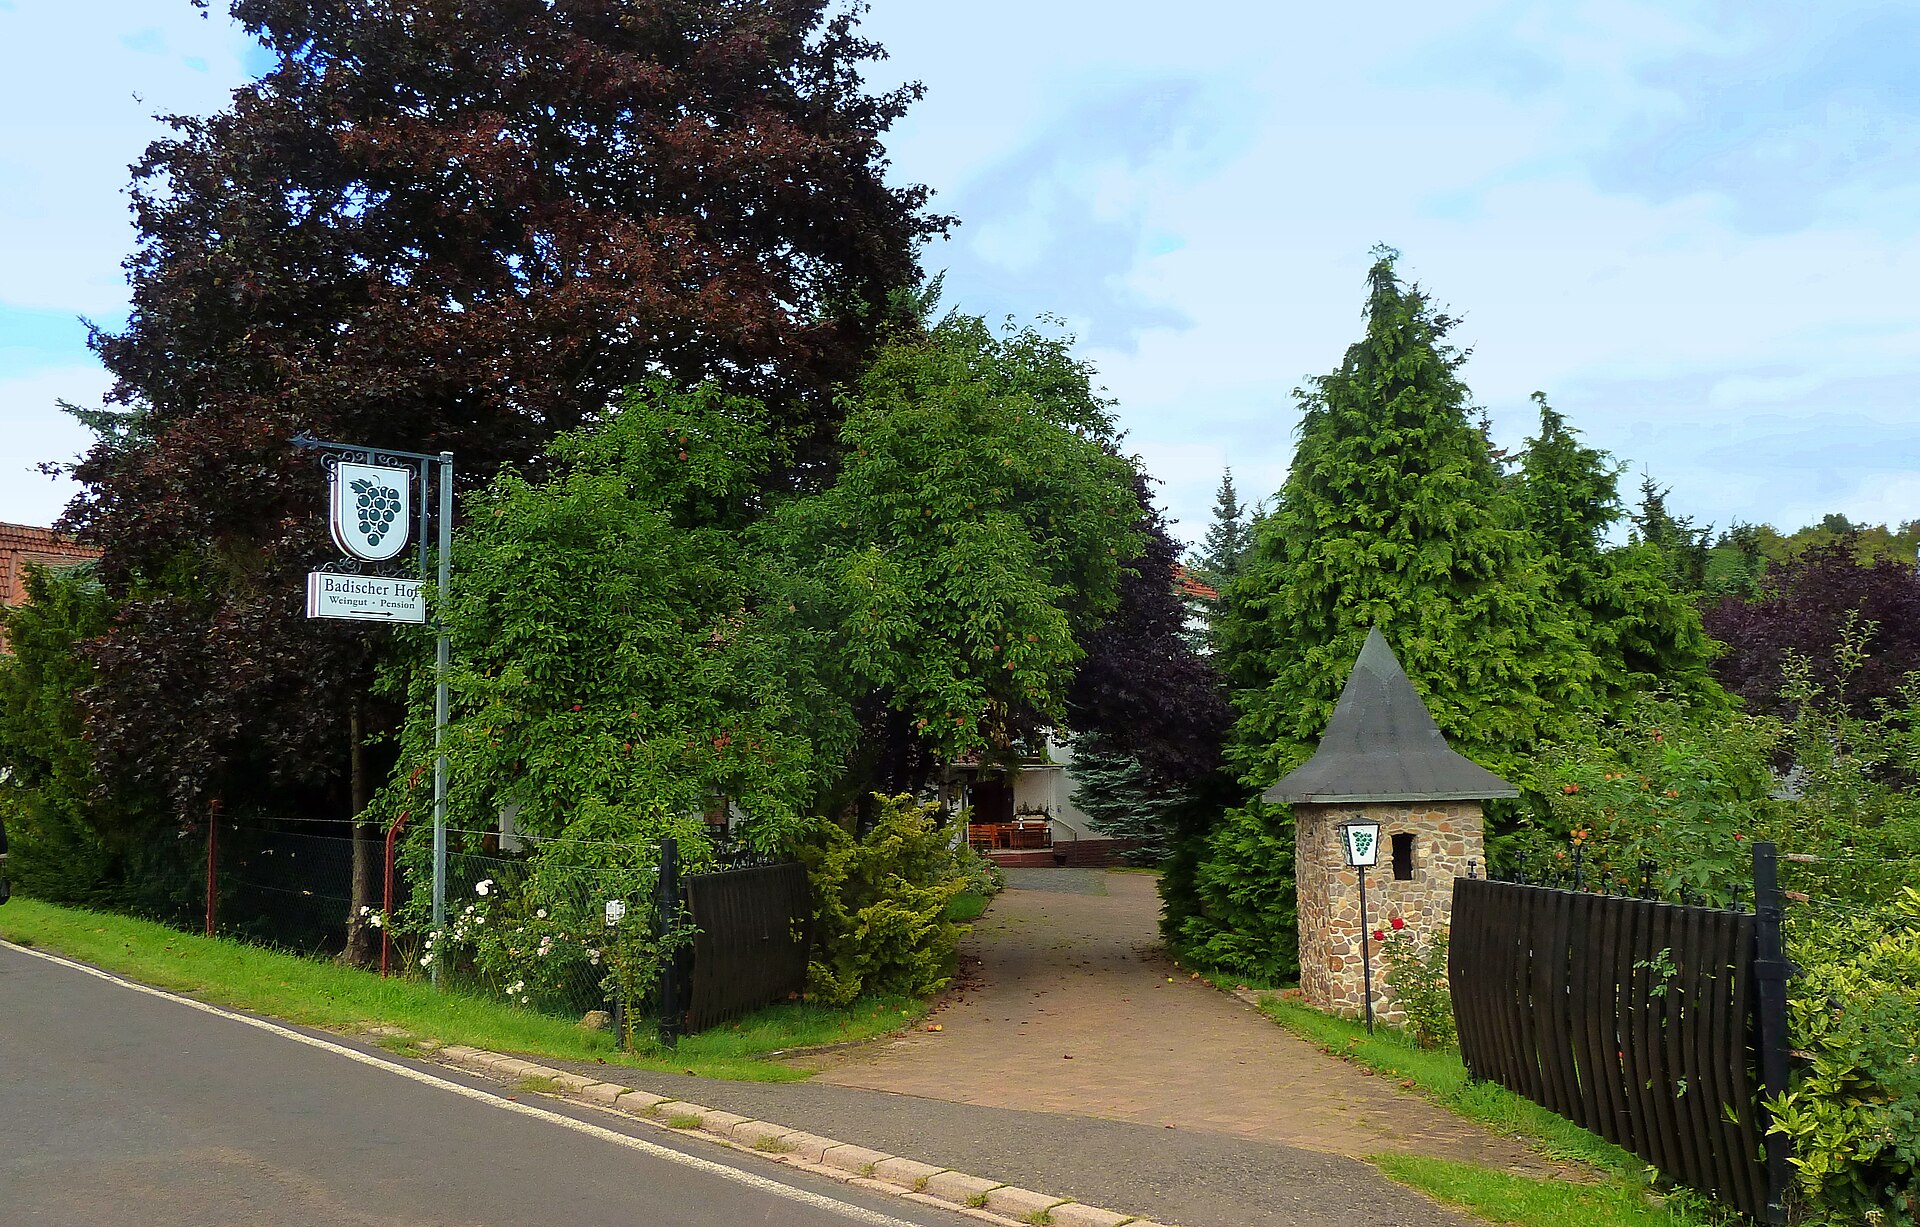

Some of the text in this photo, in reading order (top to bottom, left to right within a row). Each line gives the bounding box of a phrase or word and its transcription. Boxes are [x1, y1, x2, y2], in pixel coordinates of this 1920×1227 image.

[325, 578, 420, 598] Badischer Hof
[329, 595, 368, 607] Weingut
[380, 599, 415, 609] Pension
